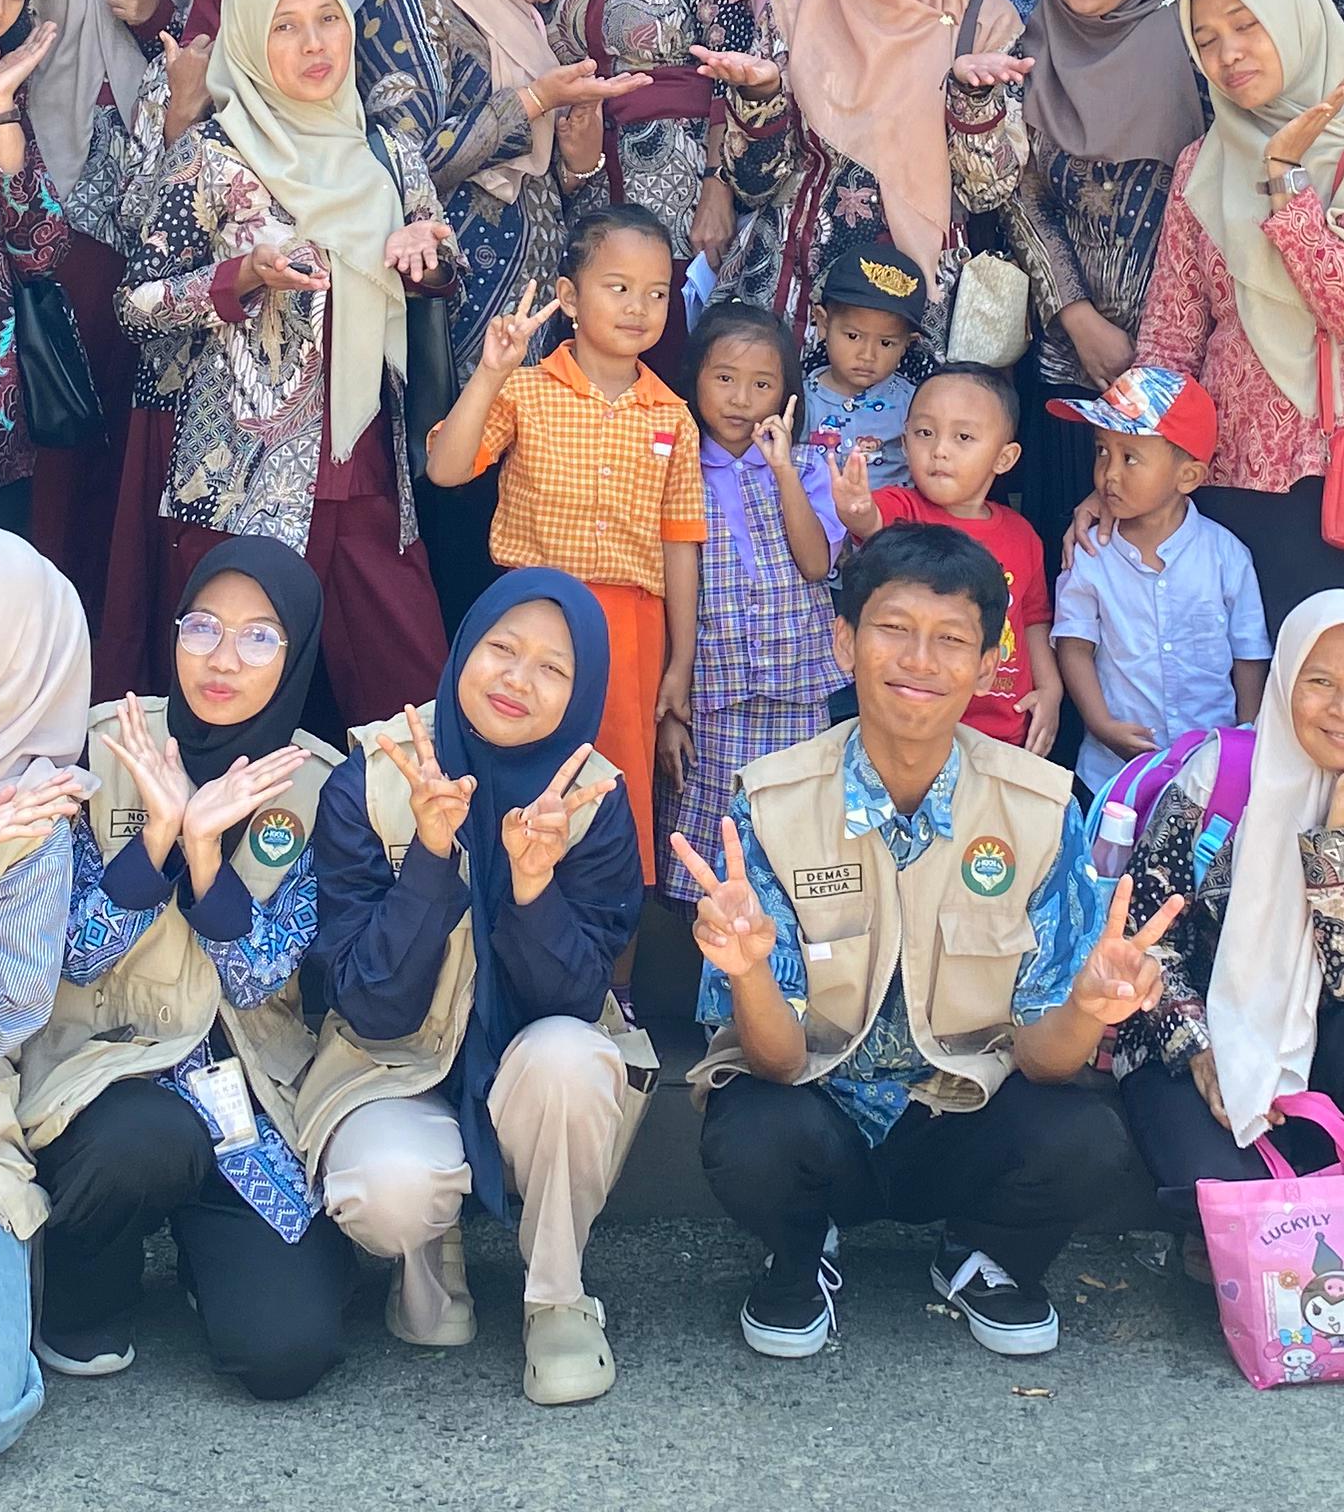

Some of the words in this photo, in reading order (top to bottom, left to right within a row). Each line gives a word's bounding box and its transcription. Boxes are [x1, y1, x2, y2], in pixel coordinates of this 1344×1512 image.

[806, 868, 850, 882] DEMAS
[809, 882, 850, 895] KETUA
[1259, 1213, 1331, 1246] LUCKYLY
